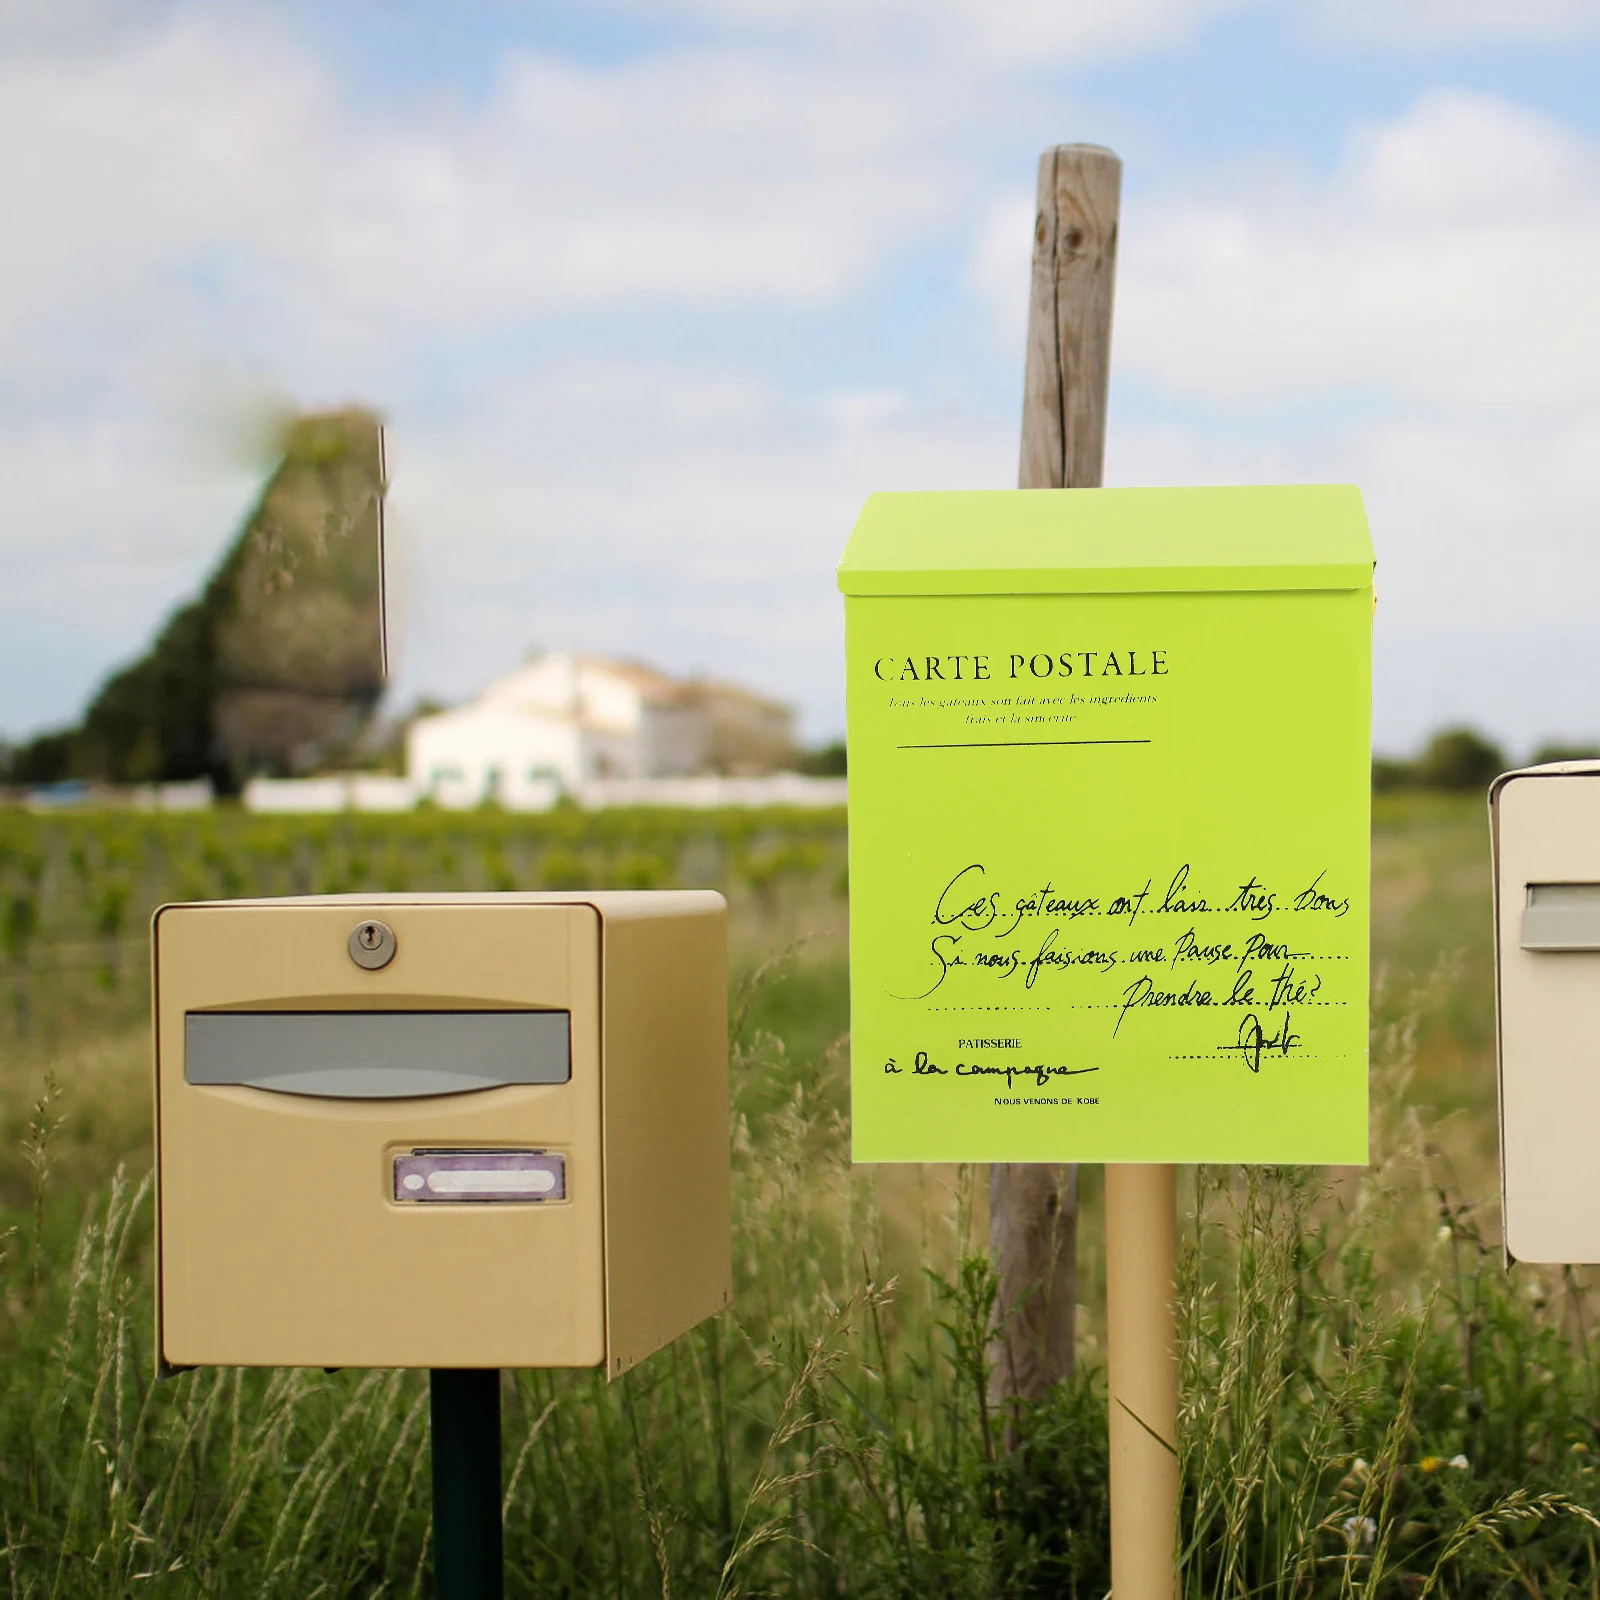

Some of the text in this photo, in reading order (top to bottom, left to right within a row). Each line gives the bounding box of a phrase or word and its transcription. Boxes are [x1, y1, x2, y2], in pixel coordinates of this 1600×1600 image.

[874, 650, 1169, 681] CARTE POSTALE
[935, 864, 1000, 931] Ces
[1105, 879, 1152, 927] ont
[884, 934, 966, 1000] Si
[974, 950, 1021, 979] nous
[1129, 947, 1166, 963] une
[1223, 969, 1255, 1006] le
[958, 1038, 1022, 1049] PATISSERIE
[884, 1058, 903, 1074] à
[911, 1051, 949, 1075] la
[1061, 1097, 1073, 1105] DE
[1077, 1097, 1100, 1105] KOBE
